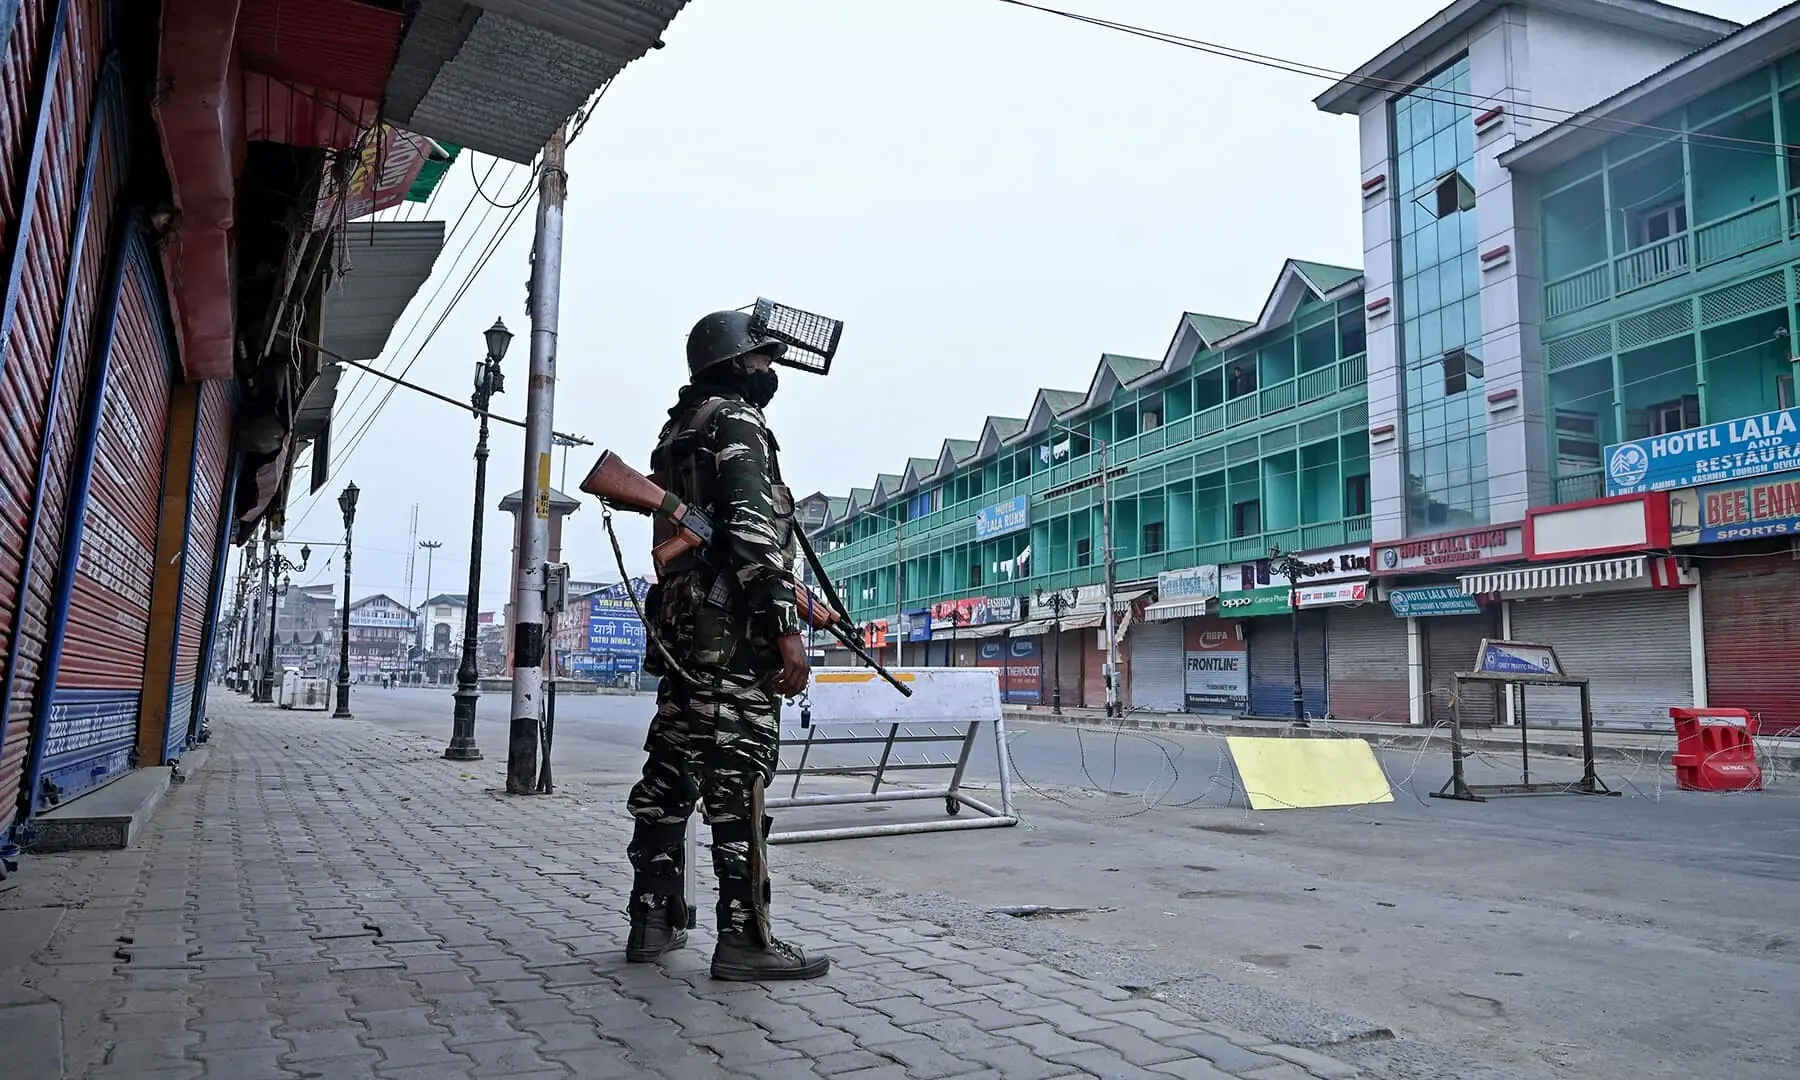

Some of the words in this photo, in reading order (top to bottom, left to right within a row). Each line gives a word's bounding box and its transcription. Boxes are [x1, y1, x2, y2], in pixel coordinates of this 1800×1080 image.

[1651, 428, 1721, 459] HOTEL
[1728, 411, 1797, 444] LALA
[1747, 437, 1783, 450] AND
[1618, 486, 1634, 494] UNIT
[1637, 484, 1646, 492] OF
[1650, 478, 1677, 491] JAMMU
[1680, 477, 1687, 485] &
[1691, 471, 1728, 483] KASHMIR
[1732, 463, 1768, 477] TOURISM
[995, 501, 1015, 515] HOTEL
[1706, 491, 1748, 525] BEE
[986, 517, 1003, 532] LALA
[1004, 510, 1025, 528] RUKH
[1717, 523, 1788, 540] SPORTS
[1400, 543, 1435, 560] HOTEL
[1435, 536, 1467, 555] LALA
[1469, 530, 1507, 550] RUKH
[1405, 589, 1427, 601] HOTEL
[1427, 588, 1447, 600] LALA
[1222, 597, 1251, 609] oppo
[593, 621, 616, 635] यात्री
[590, 636, 609, 644] YATRI
[610, 637, 631, 645] NIWAS
